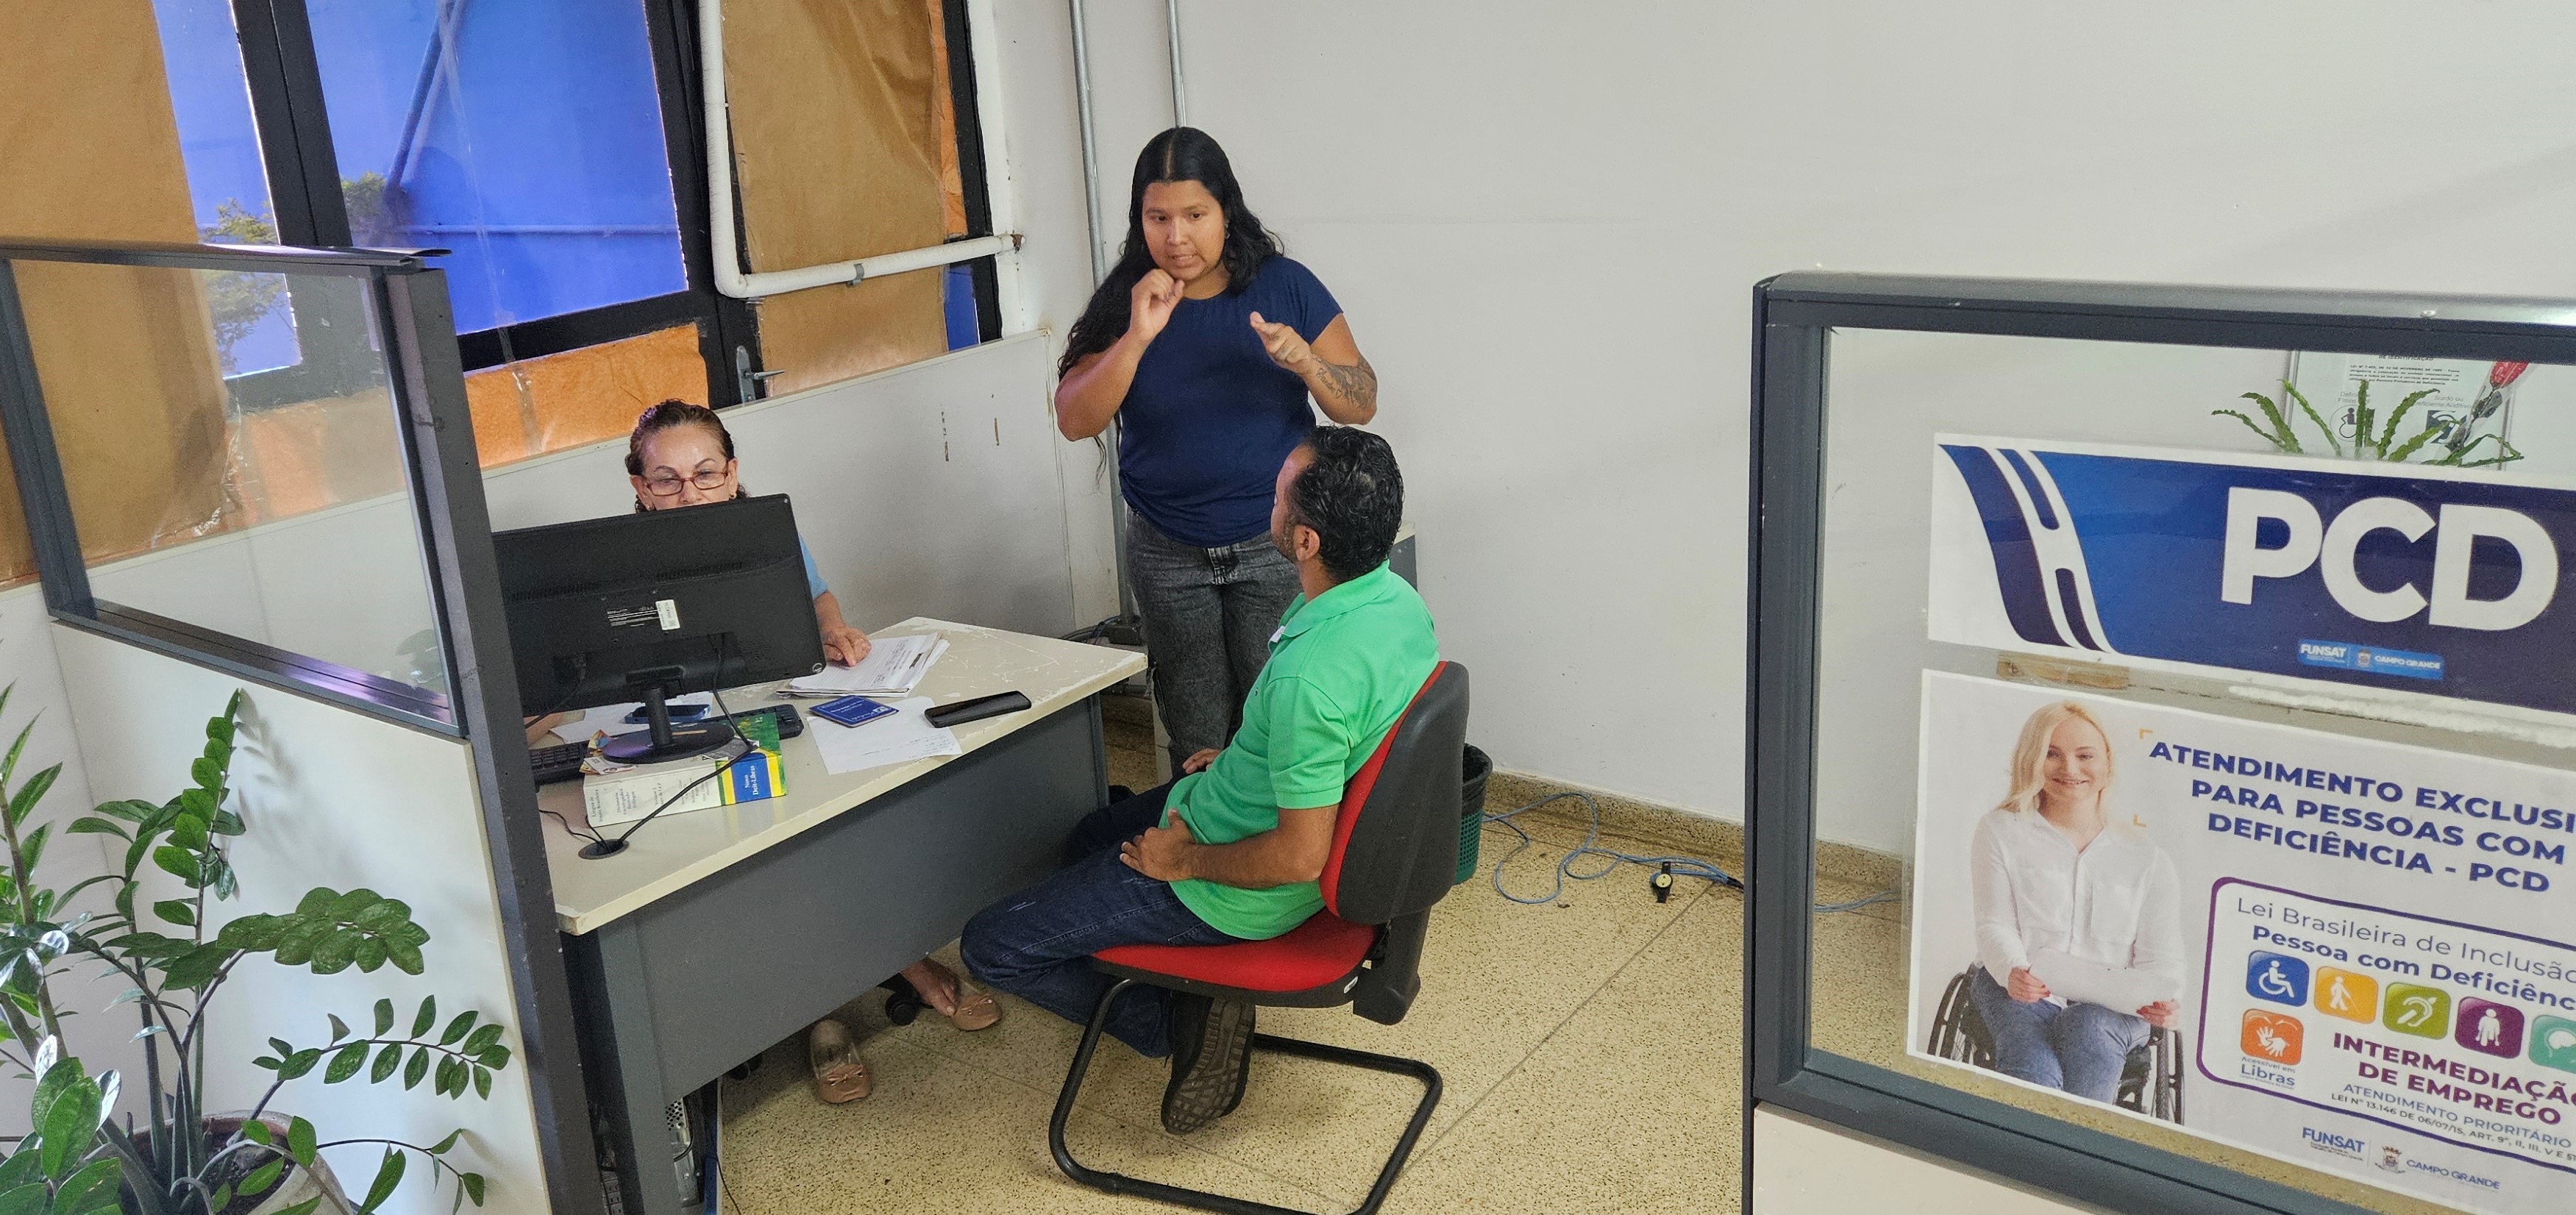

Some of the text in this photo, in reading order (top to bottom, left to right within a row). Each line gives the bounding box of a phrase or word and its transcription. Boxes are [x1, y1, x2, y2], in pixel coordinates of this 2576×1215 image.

[2221, 486, 2559, 631] PCD
[2301, 644, 2441, 669] FUNSAT CAMPO GRANDE
[2149, 741, 2576, 833] ATENDIMENTO EXCLUSI
[2191, 779, 2565, 865] PARA PESSOAS COM
[2208, 813, 2433, 874] DEFICIÊNCIA
[2469, 862, 2550, 891] PCD
[2238, 897, 2273, 919] Lei
[2283, 907, 2406, 947] Brasileira
[2416, 936, 2451, 955] de
[2252, 924, 2576, 1011] Pessoa com Deficiênc
[2241, 1063, 2295, 1086] Libras
[2333, 1033, 2576, 1106] INTERMEDIAÇÃ
[2358, 1061, 2561, 1125] DE EMPREGO
[2302, 1127, 2365, 1153] FUNSAT
[2331, 1093, 2347, 1102] LEI
[2366, 1100, 2397, 1115] 13.146
[2399, 1110, 2415, 1120] DE
[2469, 1130, 2494, 1142] ART.
[2556, 1150, 2564, 1158] E
[2343, 1083, 2572, 1148] ATENDIMENTO PRIORITÁRIO
[2406, 1159, 2501, 1190] CAMPO GRANDE
